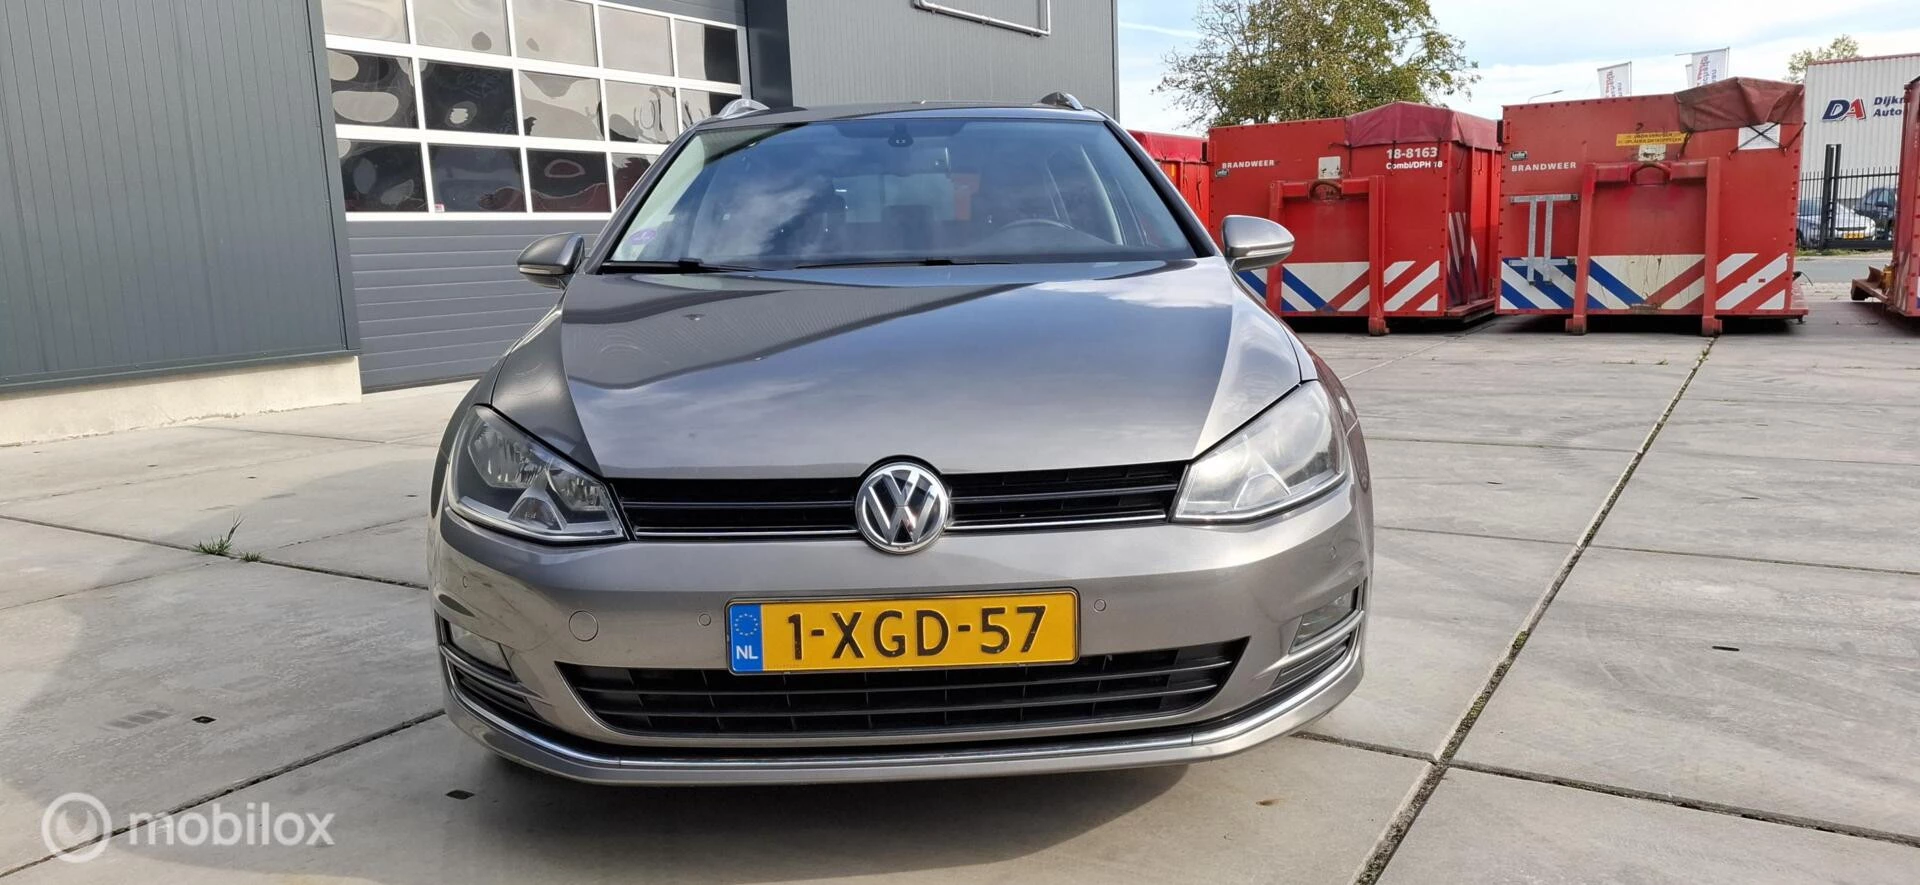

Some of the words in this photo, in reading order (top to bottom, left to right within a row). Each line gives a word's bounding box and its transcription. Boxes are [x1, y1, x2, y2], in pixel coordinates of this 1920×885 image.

[1822, 98, 1867, 121] DA
[1873, 108, 1903, 117] Auto
[1386, 147, 1438, 159] 18-8163
[1222, 160, 1275, 169] BRANDWEER
[1511, 162, 1577, 172] BRANDWEER
[787, 605, 1048, 661] 1-XGD-57
[736, 645, 759, 660] NL
